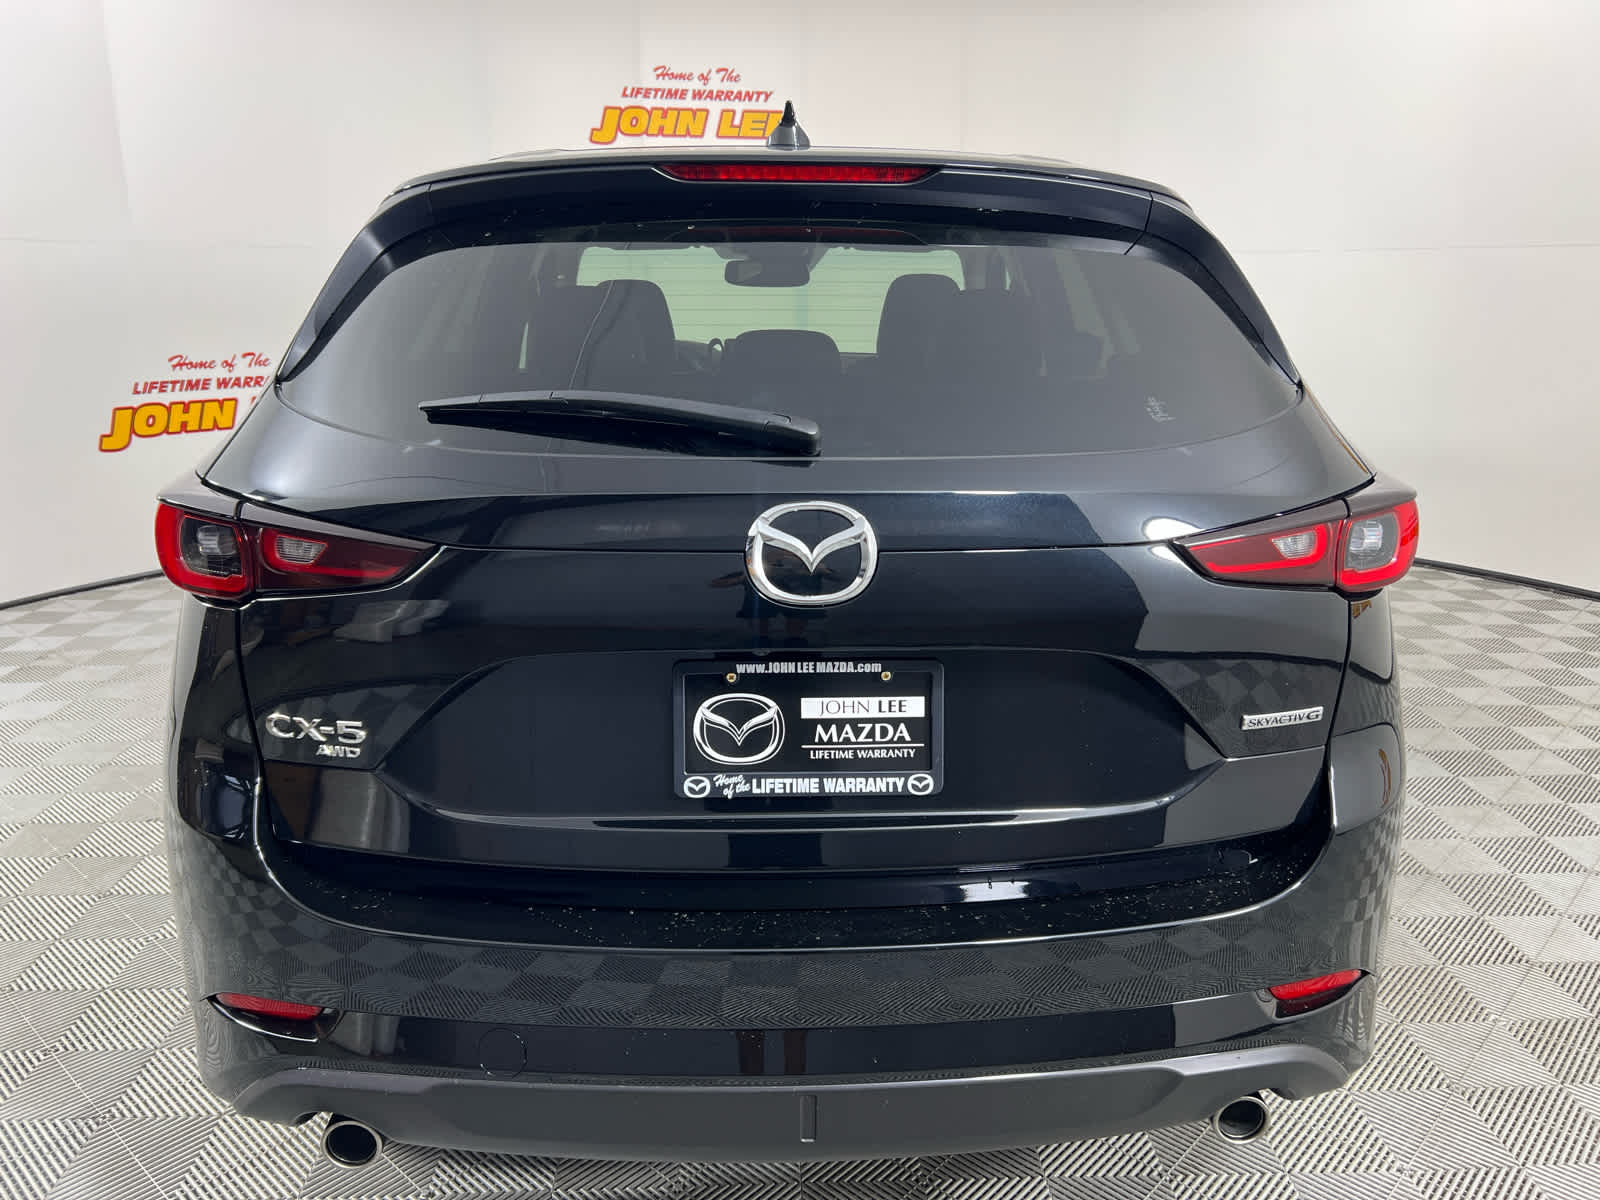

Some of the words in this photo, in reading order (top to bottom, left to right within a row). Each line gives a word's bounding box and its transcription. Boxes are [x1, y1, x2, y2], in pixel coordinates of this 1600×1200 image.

[653, 65, 694, 81] Home
[697, 69, 711, 86] of
[715, 67, 742, 82] The
[622, 87, 688, 101] LIFETIME
[691, 89, 773, 103] WARRANTY
[589, 105, 709, 144] JOHN
[168, 354, 216, 371] Home
[221, 354, 237, 372] of
[241, 352, 270, 367] The
[132, 378, 212, 395] LIFETIME
[98, 398, 238, 452] JOHN
[736, 662, 796, 673] www.JOHN
[797, 662, 815, 673] LEE
[816, 662, 882, 673] MAZDA.com
[819, 700, 870, 717] JOHN
[877, 699, 907, 713] LEE
[265, 712, 368, 743] CX-5
[814, 723, 911, 743] MAZDA
[315, 744, 361, 758] AWD
[810, 749, 854, 760] LIFETIME
[857, 749, 915, 759] WARRANTY
[713, 774, 744, 789] Home
[722, 785, 735, 799] of
[735, 781, 751, 794] the
[752, 778, 820, 794] LIFETIME
[823, 778, 905, 793] WARRANTY
